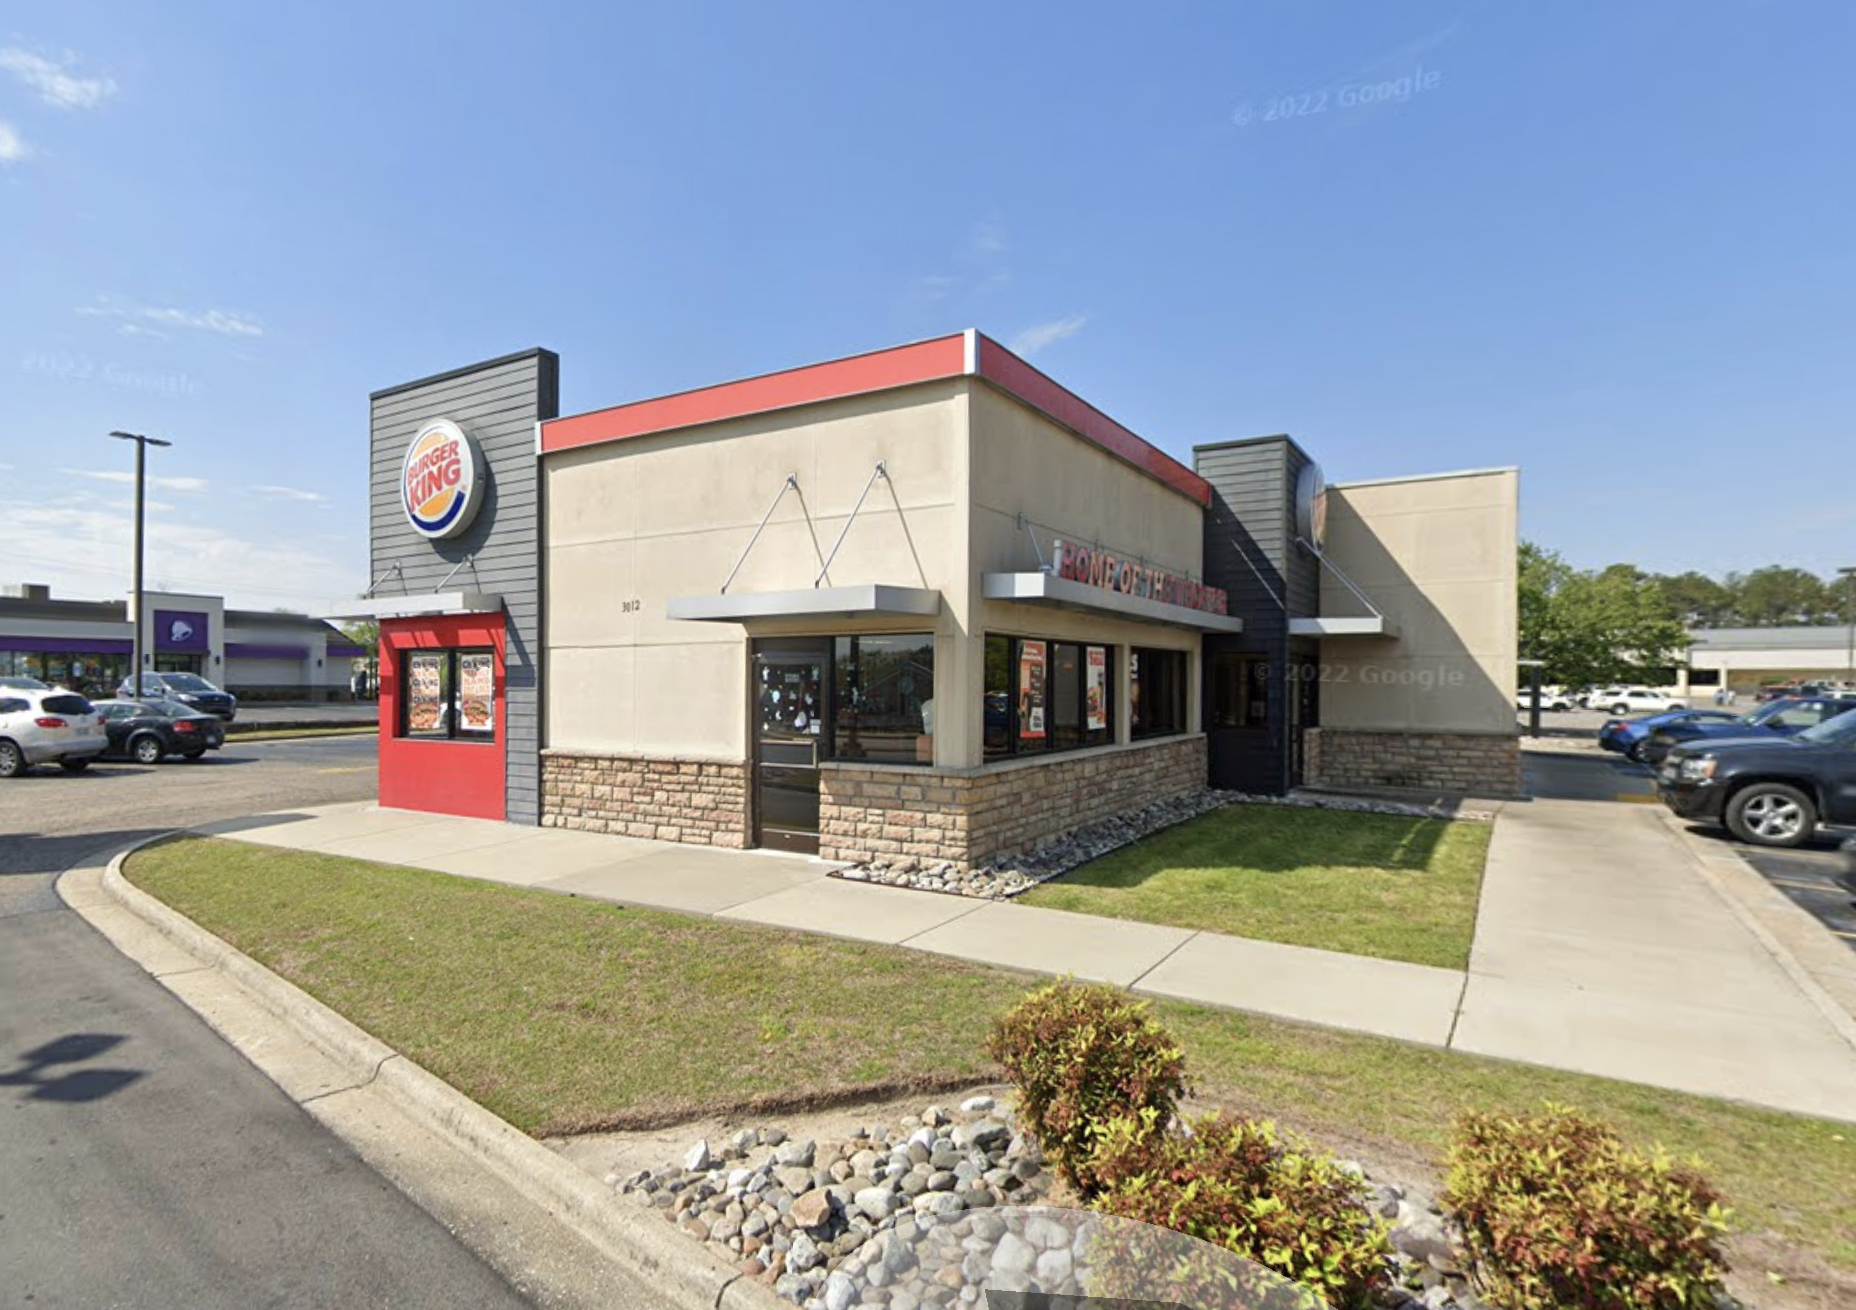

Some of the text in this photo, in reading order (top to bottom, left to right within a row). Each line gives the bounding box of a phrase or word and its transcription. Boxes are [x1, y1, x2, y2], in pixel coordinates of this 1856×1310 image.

[407, 440, 459, 485] BURGER
[409, 458, 461, 514] KING
[1060, 541, 1116, 593] HOME
[1119, 560, 1142, 596] OF
